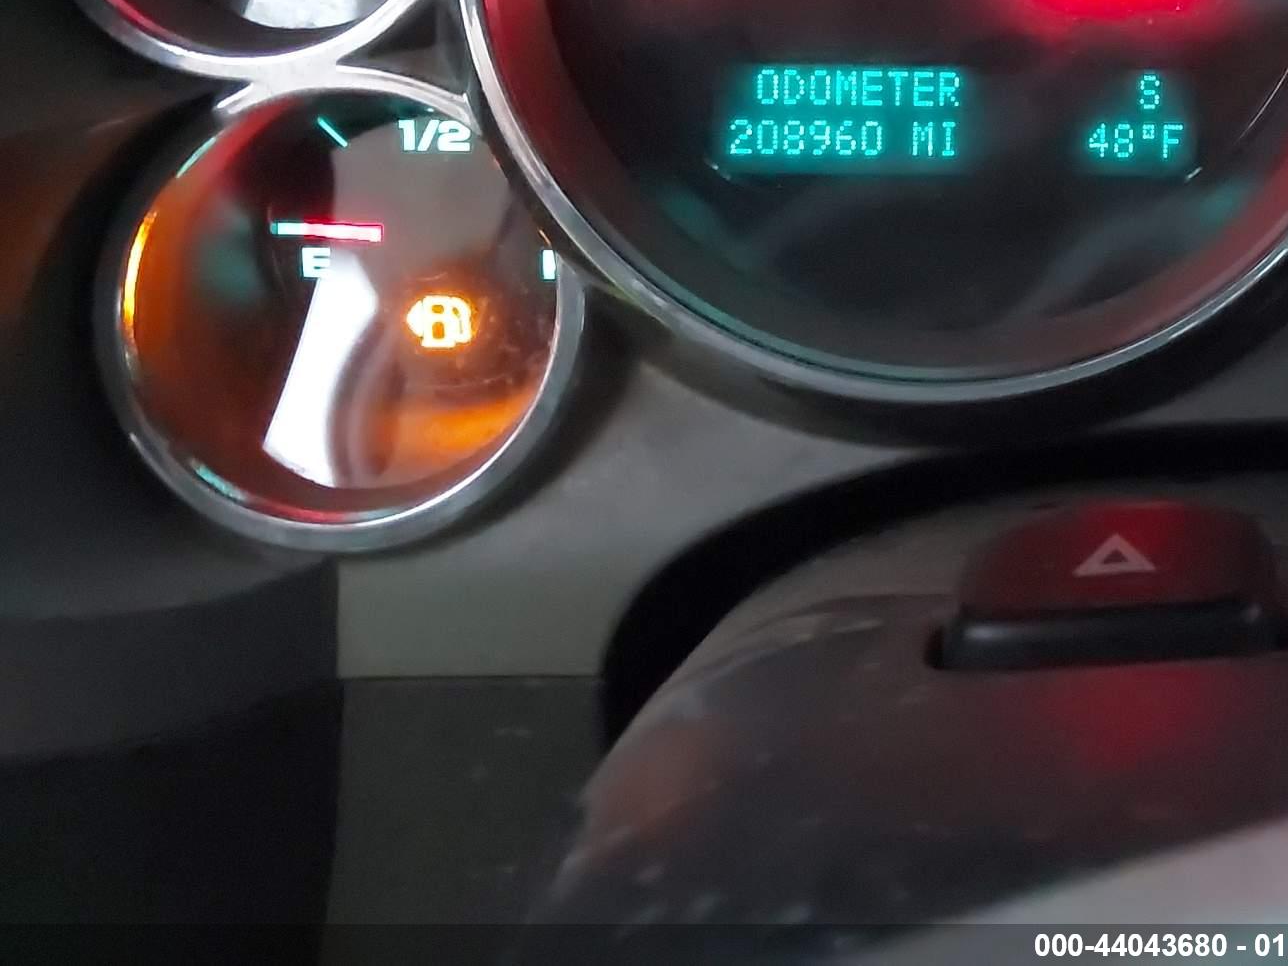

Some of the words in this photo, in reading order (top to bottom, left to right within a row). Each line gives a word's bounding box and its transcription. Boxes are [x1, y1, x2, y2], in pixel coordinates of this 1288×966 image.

[757, 69, 960, 107] ODOMETER
[398, 120, 472, 152] 1/2
[729, 119, 883, 155] 208960
[911, 121, 957, 157] MI
[1088, 123, 1184, 159] 48°F
[302, 246, 332, 278] E
